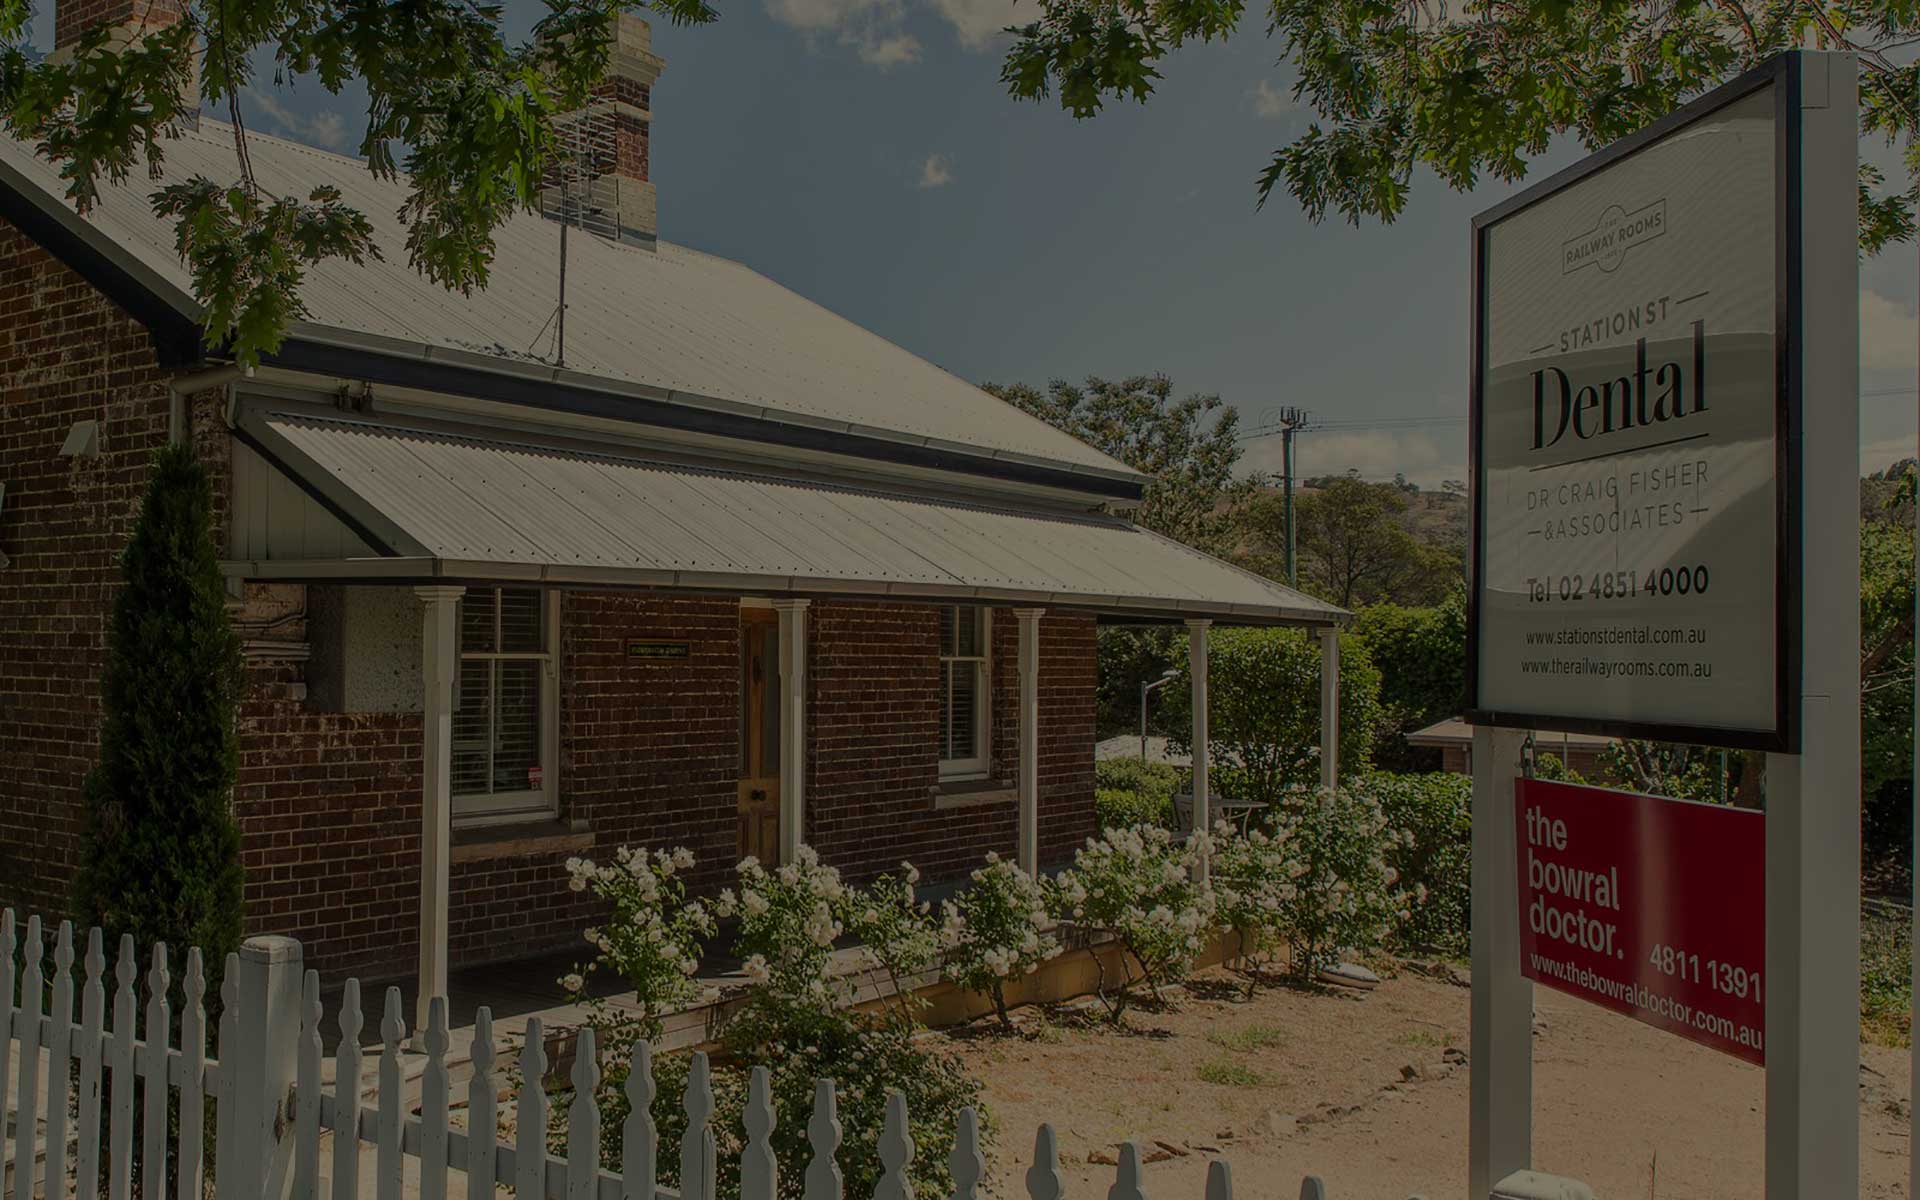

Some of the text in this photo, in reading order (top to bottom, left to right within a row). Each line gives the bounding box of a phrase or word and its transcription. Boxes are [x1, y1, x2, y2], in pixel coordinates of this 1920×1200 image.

[1566, 212, 1662, 264] RAILWAY ROOMS
[1560, 296, 1670, 352] STATION ST
[1529, 318, 1709, 450] Dental
[1527, 460, 1708, 511] DR CRAIG FISHER
[1527, 565, 1709, 602] Tel 02 4851 4000
[1526, 625, 1706, 645] www.stationstdental.com.au
[1521, 656, 1712, 679] www.therailwayrooms.com.au
[1526, 805, 1568, 850] the
[1528, 847, 1620, 911] bowral
[1529, 894, 1624, 960] doctor.
[1650, 943, 1761, 1003] 4811 1391
[1530, 952, 1763, 1050] www.thebowraldoctor.com.au
